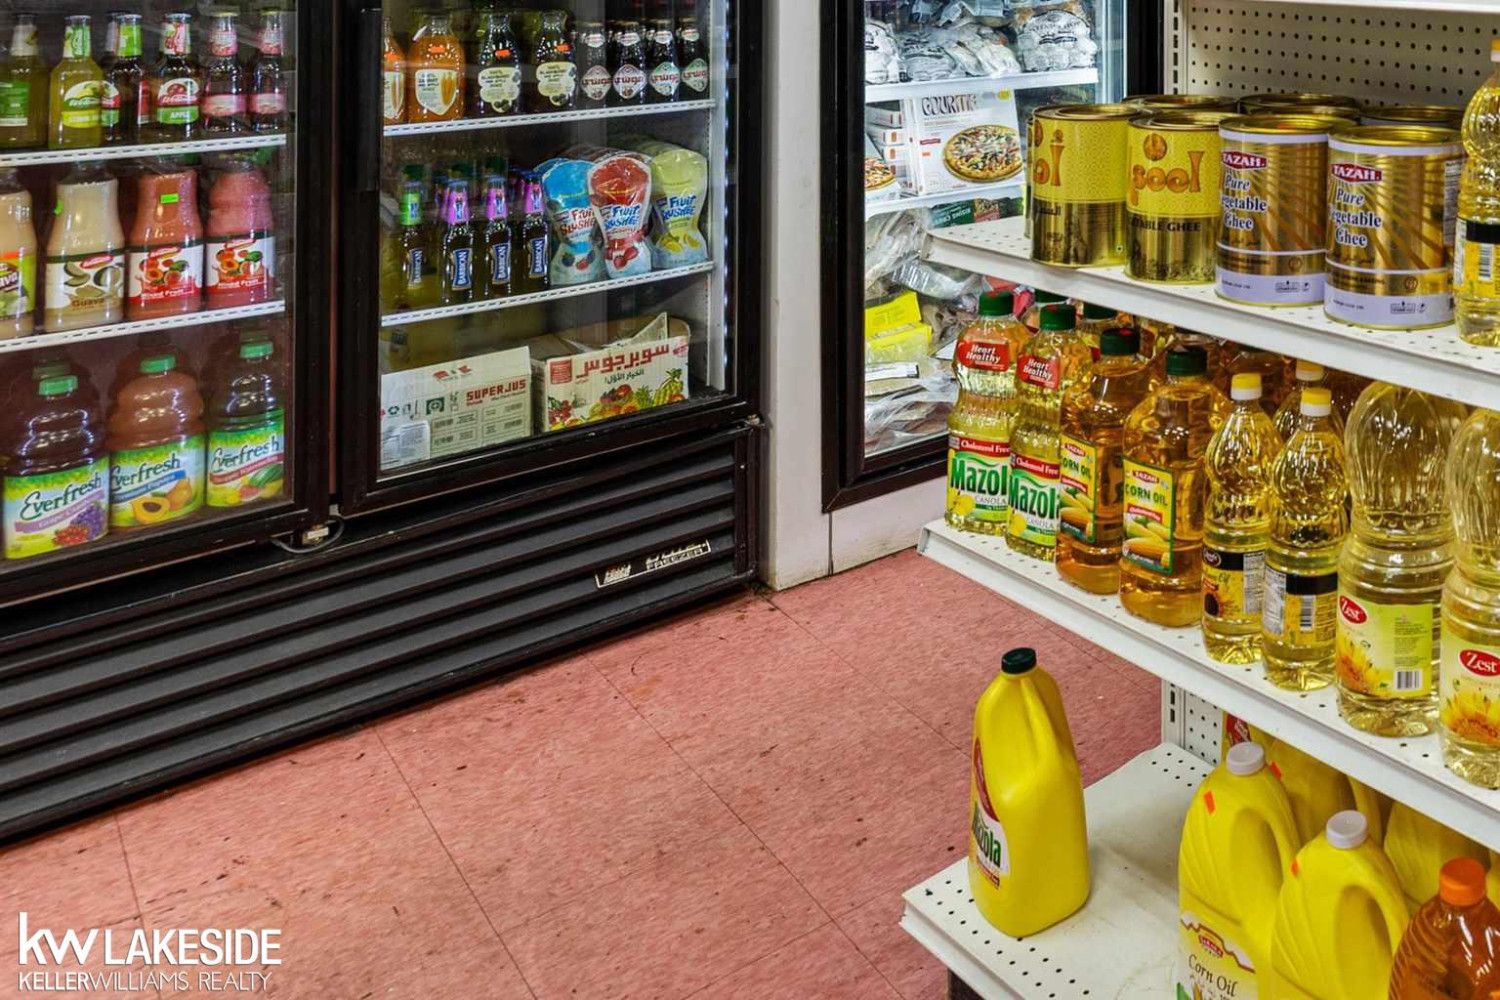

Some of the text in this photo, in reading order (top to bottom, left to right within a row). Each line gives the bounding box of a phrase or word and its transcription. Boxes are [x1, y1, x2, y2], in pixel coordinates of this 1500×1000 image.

[1225, 174, 1250, 190] Pure
[1333, 165, 1376, 181] TAZAH
[669, 195, 697, 208] FRUIT
[1222, 194, 1267, 212] egetable
[1336, 187, 1365, 206] Pure
[611, 204, 641, 218] FRUIT
[560, 219, 595, 236] SLUSHE
[1167, 221, 1201, 232] GHEE
[1224, 212, 1254, 230] Ghee
[1335, 228, 1367, 247] Ghee
[72, 298, 105, 308] Guava
[965, 351, 1001, 364] Healthy
[970, 344, 996, 355] Heart
[1023, 365, 1053, 381] Healthy
[1028, 358, 1049, 371] Heart
[466, 379, 526, 402] SUPERJUS
[211, 435, 280, 473] Everfresh
[995, 444, 1010, 453] Free
[110, 452, 180, 490] Everfresh
[951, 457, 1008, 496] Mazol
[1062, 457, 1092, 480] ORN OIL
[20, 472, 102, 521] Everfresh
[975, 496, 1007, 506] CANOLA
[1125, 484, 1169, 507] CORN OIL
[1341, 597, 1361, 621] Zest
[1466, 651, 1498, 673] Zest
[1188, 953, 1239, 998] Corn Oil
